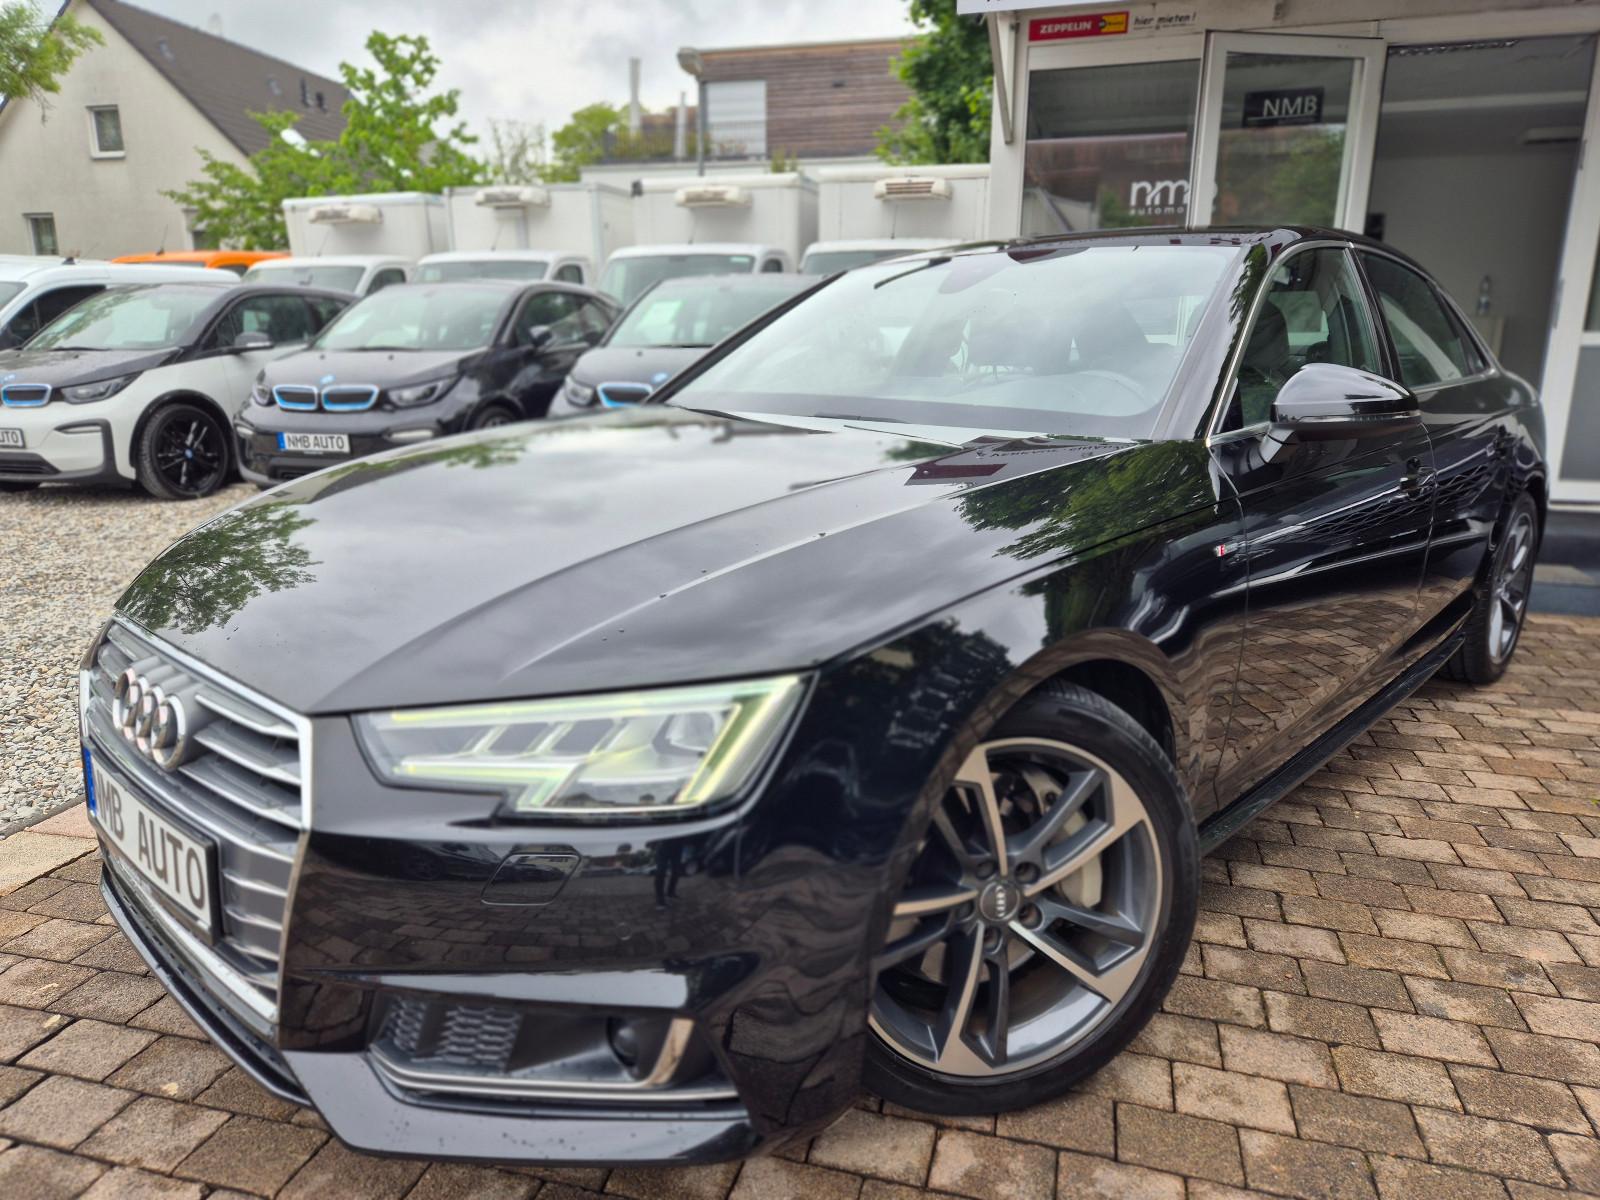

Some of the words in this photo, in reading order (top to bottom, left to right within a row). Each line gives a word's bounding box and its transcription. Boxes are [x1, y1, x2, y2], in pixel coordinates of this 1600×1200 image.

[1040, 21, 1092, 34] ZEPPELIN
[1134, 16, 1154, 25] hier
[1263, 95, 1318, 118] NMB
[1129, 179, 1218, 207] nm
[313, 435, 345, 450] AUTO
[138, 811, 205, 910] AUTO
